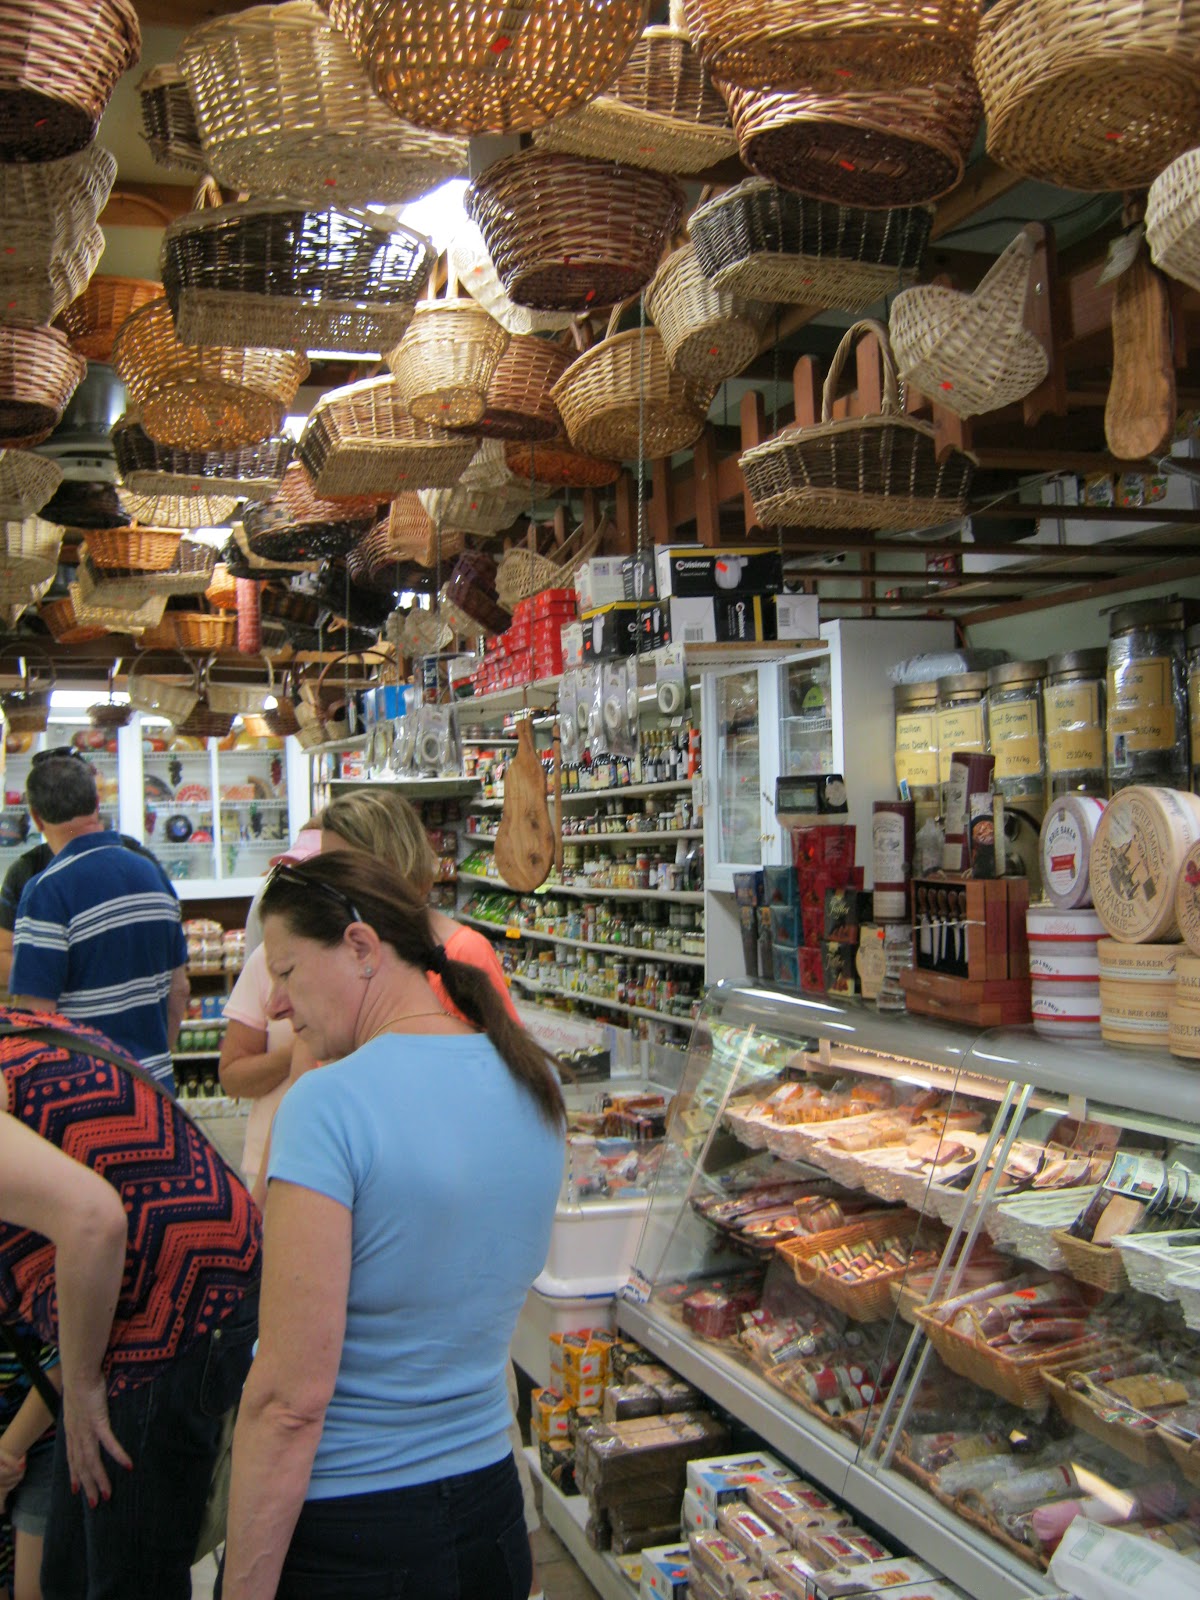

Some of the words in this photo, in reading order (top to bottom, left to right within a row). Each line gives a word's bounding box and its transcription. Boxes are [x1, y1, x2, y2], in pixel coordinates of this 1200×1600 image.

[911, 740, 929, 750] Dark
[1099, 839, 1111, 883] BRIE
[1104, 884, 1137, 918] BAKER
[1109, 914, 1129, 931] BRIE
[1136, 960, 1164, 968] BAKER
